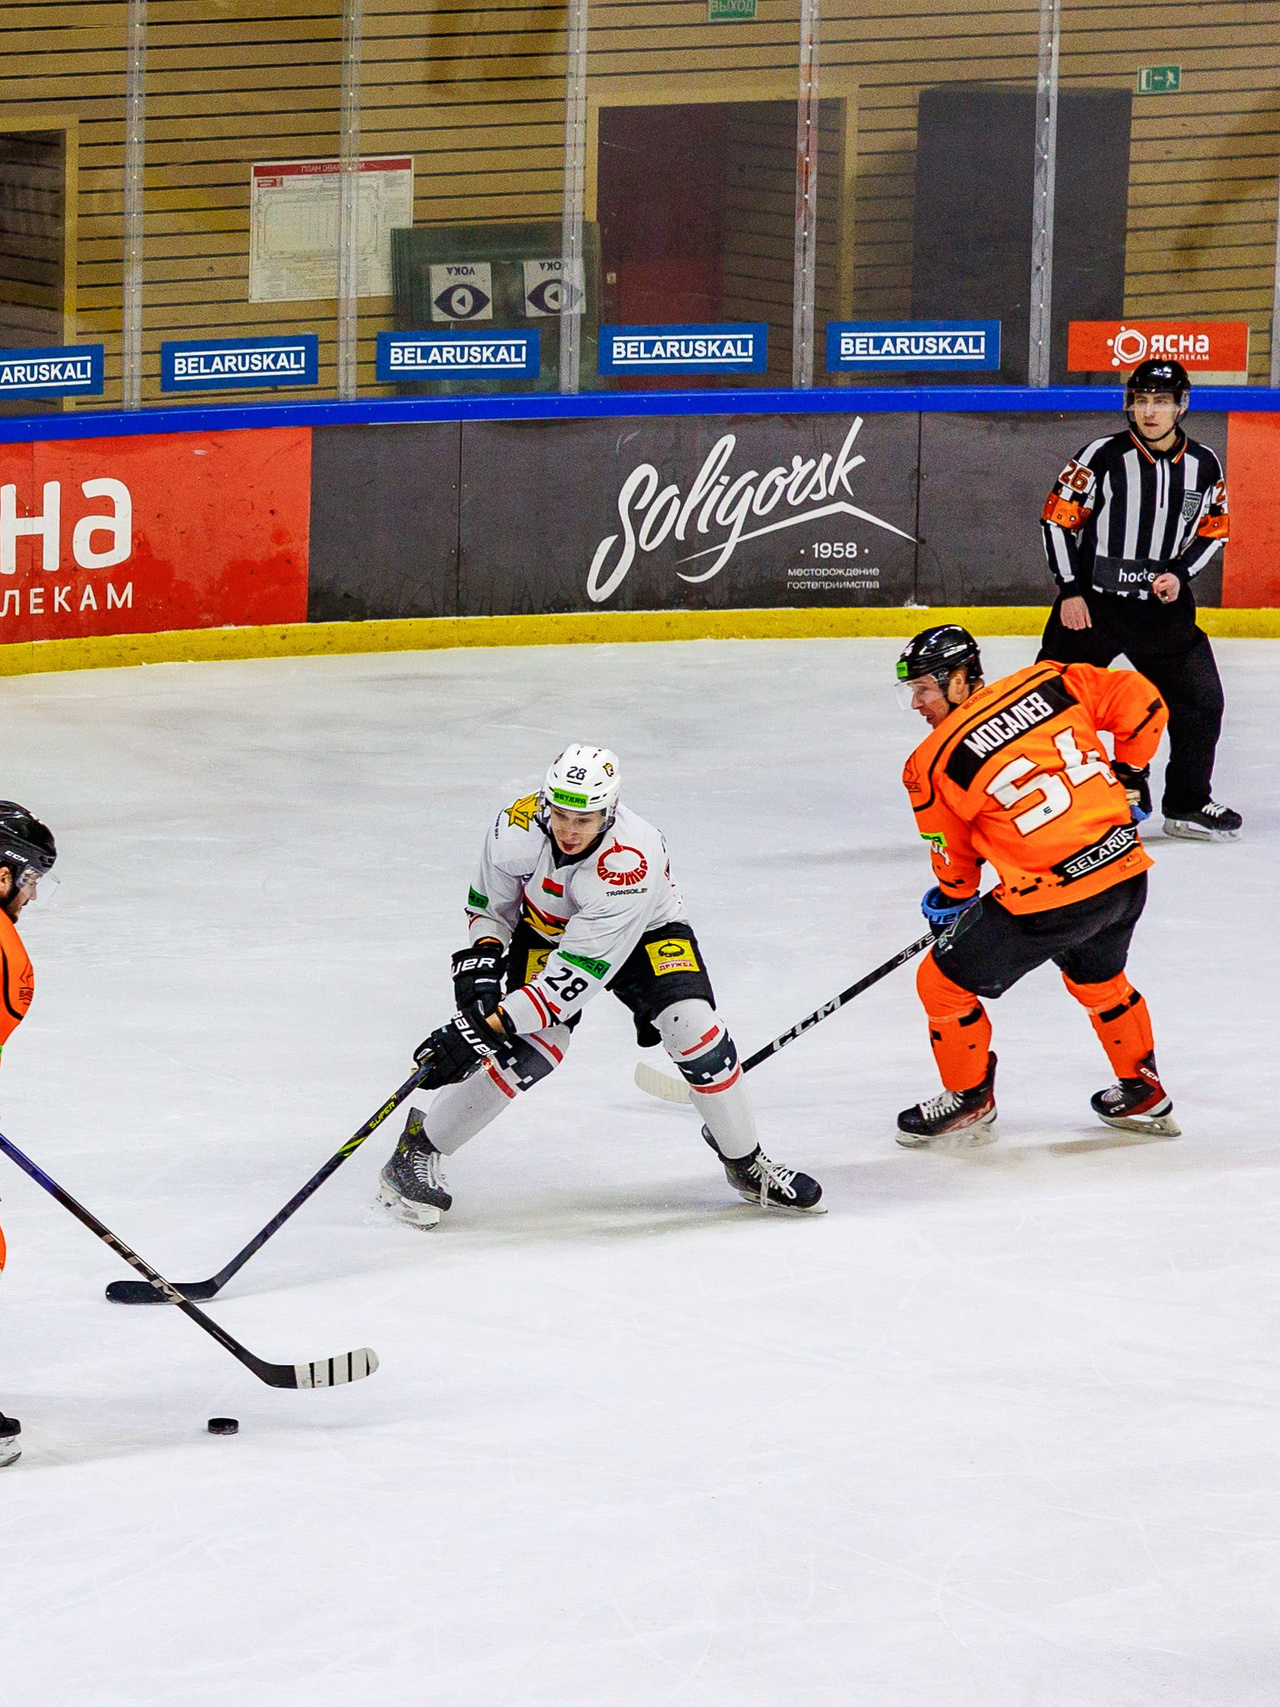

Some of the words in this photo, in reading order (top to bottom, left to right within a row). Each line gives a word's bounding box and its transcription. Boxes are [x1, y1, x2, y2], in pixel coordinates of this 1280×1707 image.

[446, 266, 476, 276] VOKA
[539, 261, 566, 272] OKA
[389, 345, 526, 365] BELARUSKALI
[612, 340, 754, 359] BELARUSKALI
[840, 336, 985, 356] BELARUSKALI
[174, 351, 306, 375] BELARUSKALI
[1060, 460, 1092, 492] 26
[586, 415, 866, 603] Soligorsk
[811, 542, 858, 559] 1958
[787, 567, 880, 578] месторождение
[786, 580, 880, 590] гостеприимства
[962, 691, 1054, 760] МОСАЛЕВ
[566, 765, 587, 781] 28
[983, 725, 1119, 838] 54
[4, 850, 29, 863] CCM
[544, 967, 588, 1002] 28
[772, 995, 841, 1052] CCM
